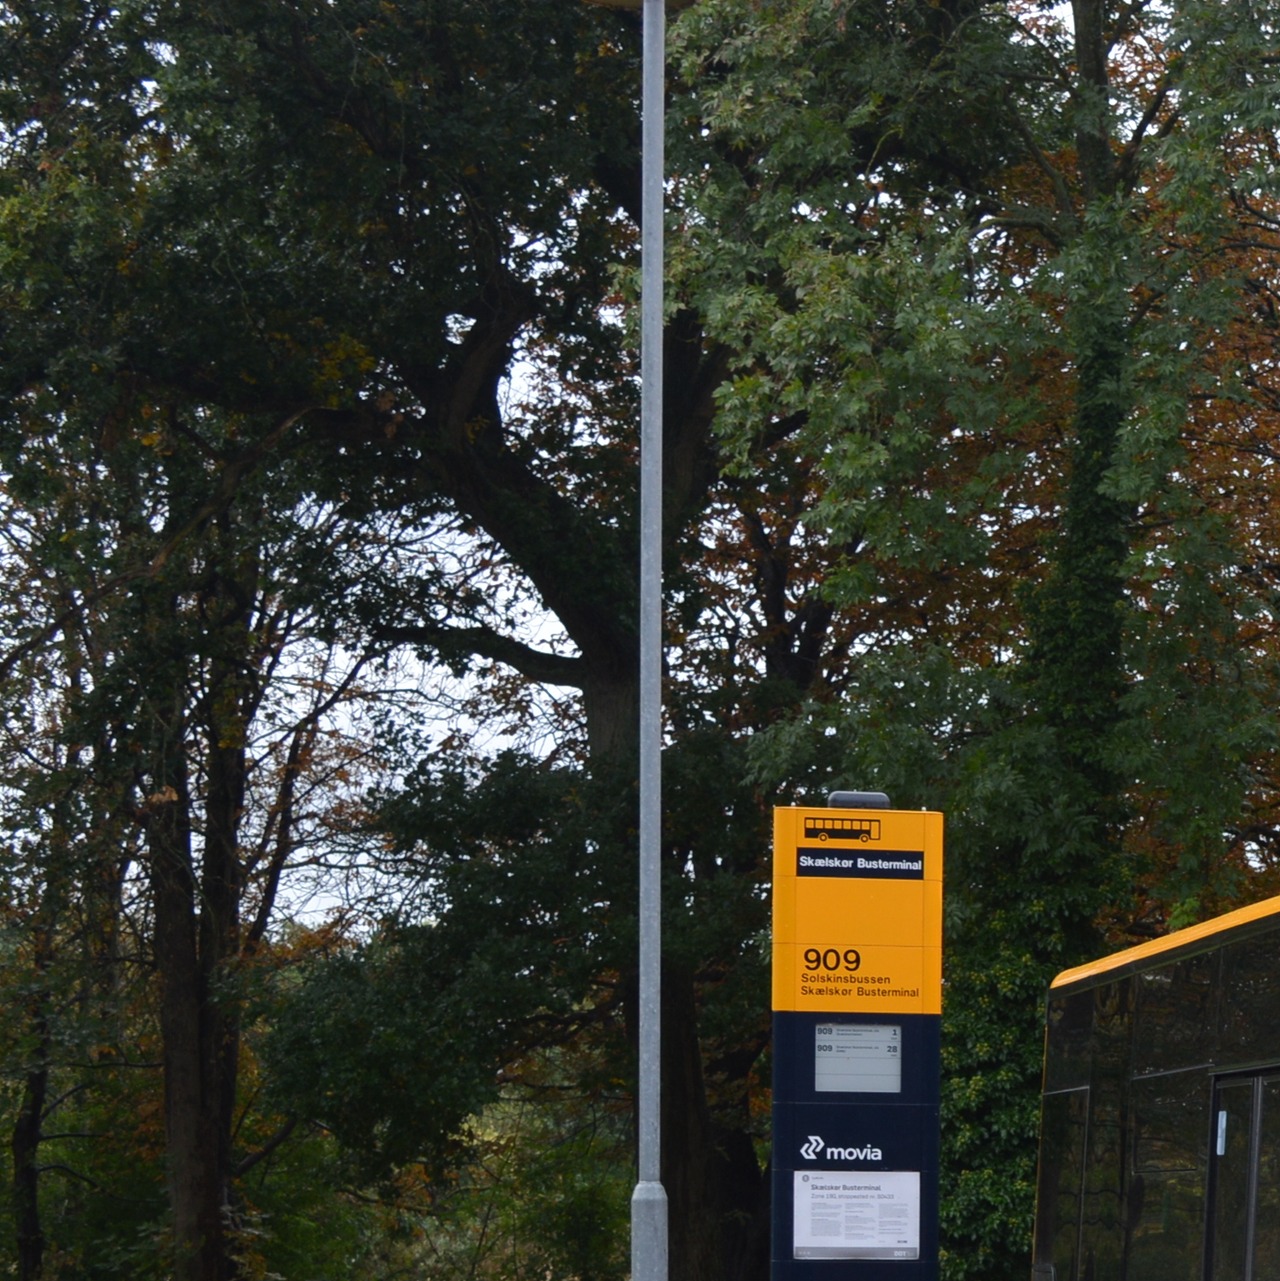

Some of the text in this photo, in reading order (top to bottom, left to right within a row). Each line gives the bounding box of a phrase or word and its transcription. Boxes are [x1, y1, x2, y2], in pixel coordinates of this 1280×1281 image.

[799, 856, 922, 870] Skælskør Busterminal
[803, 948, 861, 972] 909
[801, 973, 891, 984] Solskinsbussen
[801, 986, 919, 997] Skælskør Busterminal
[826, 1144, 882, 1160] movia
